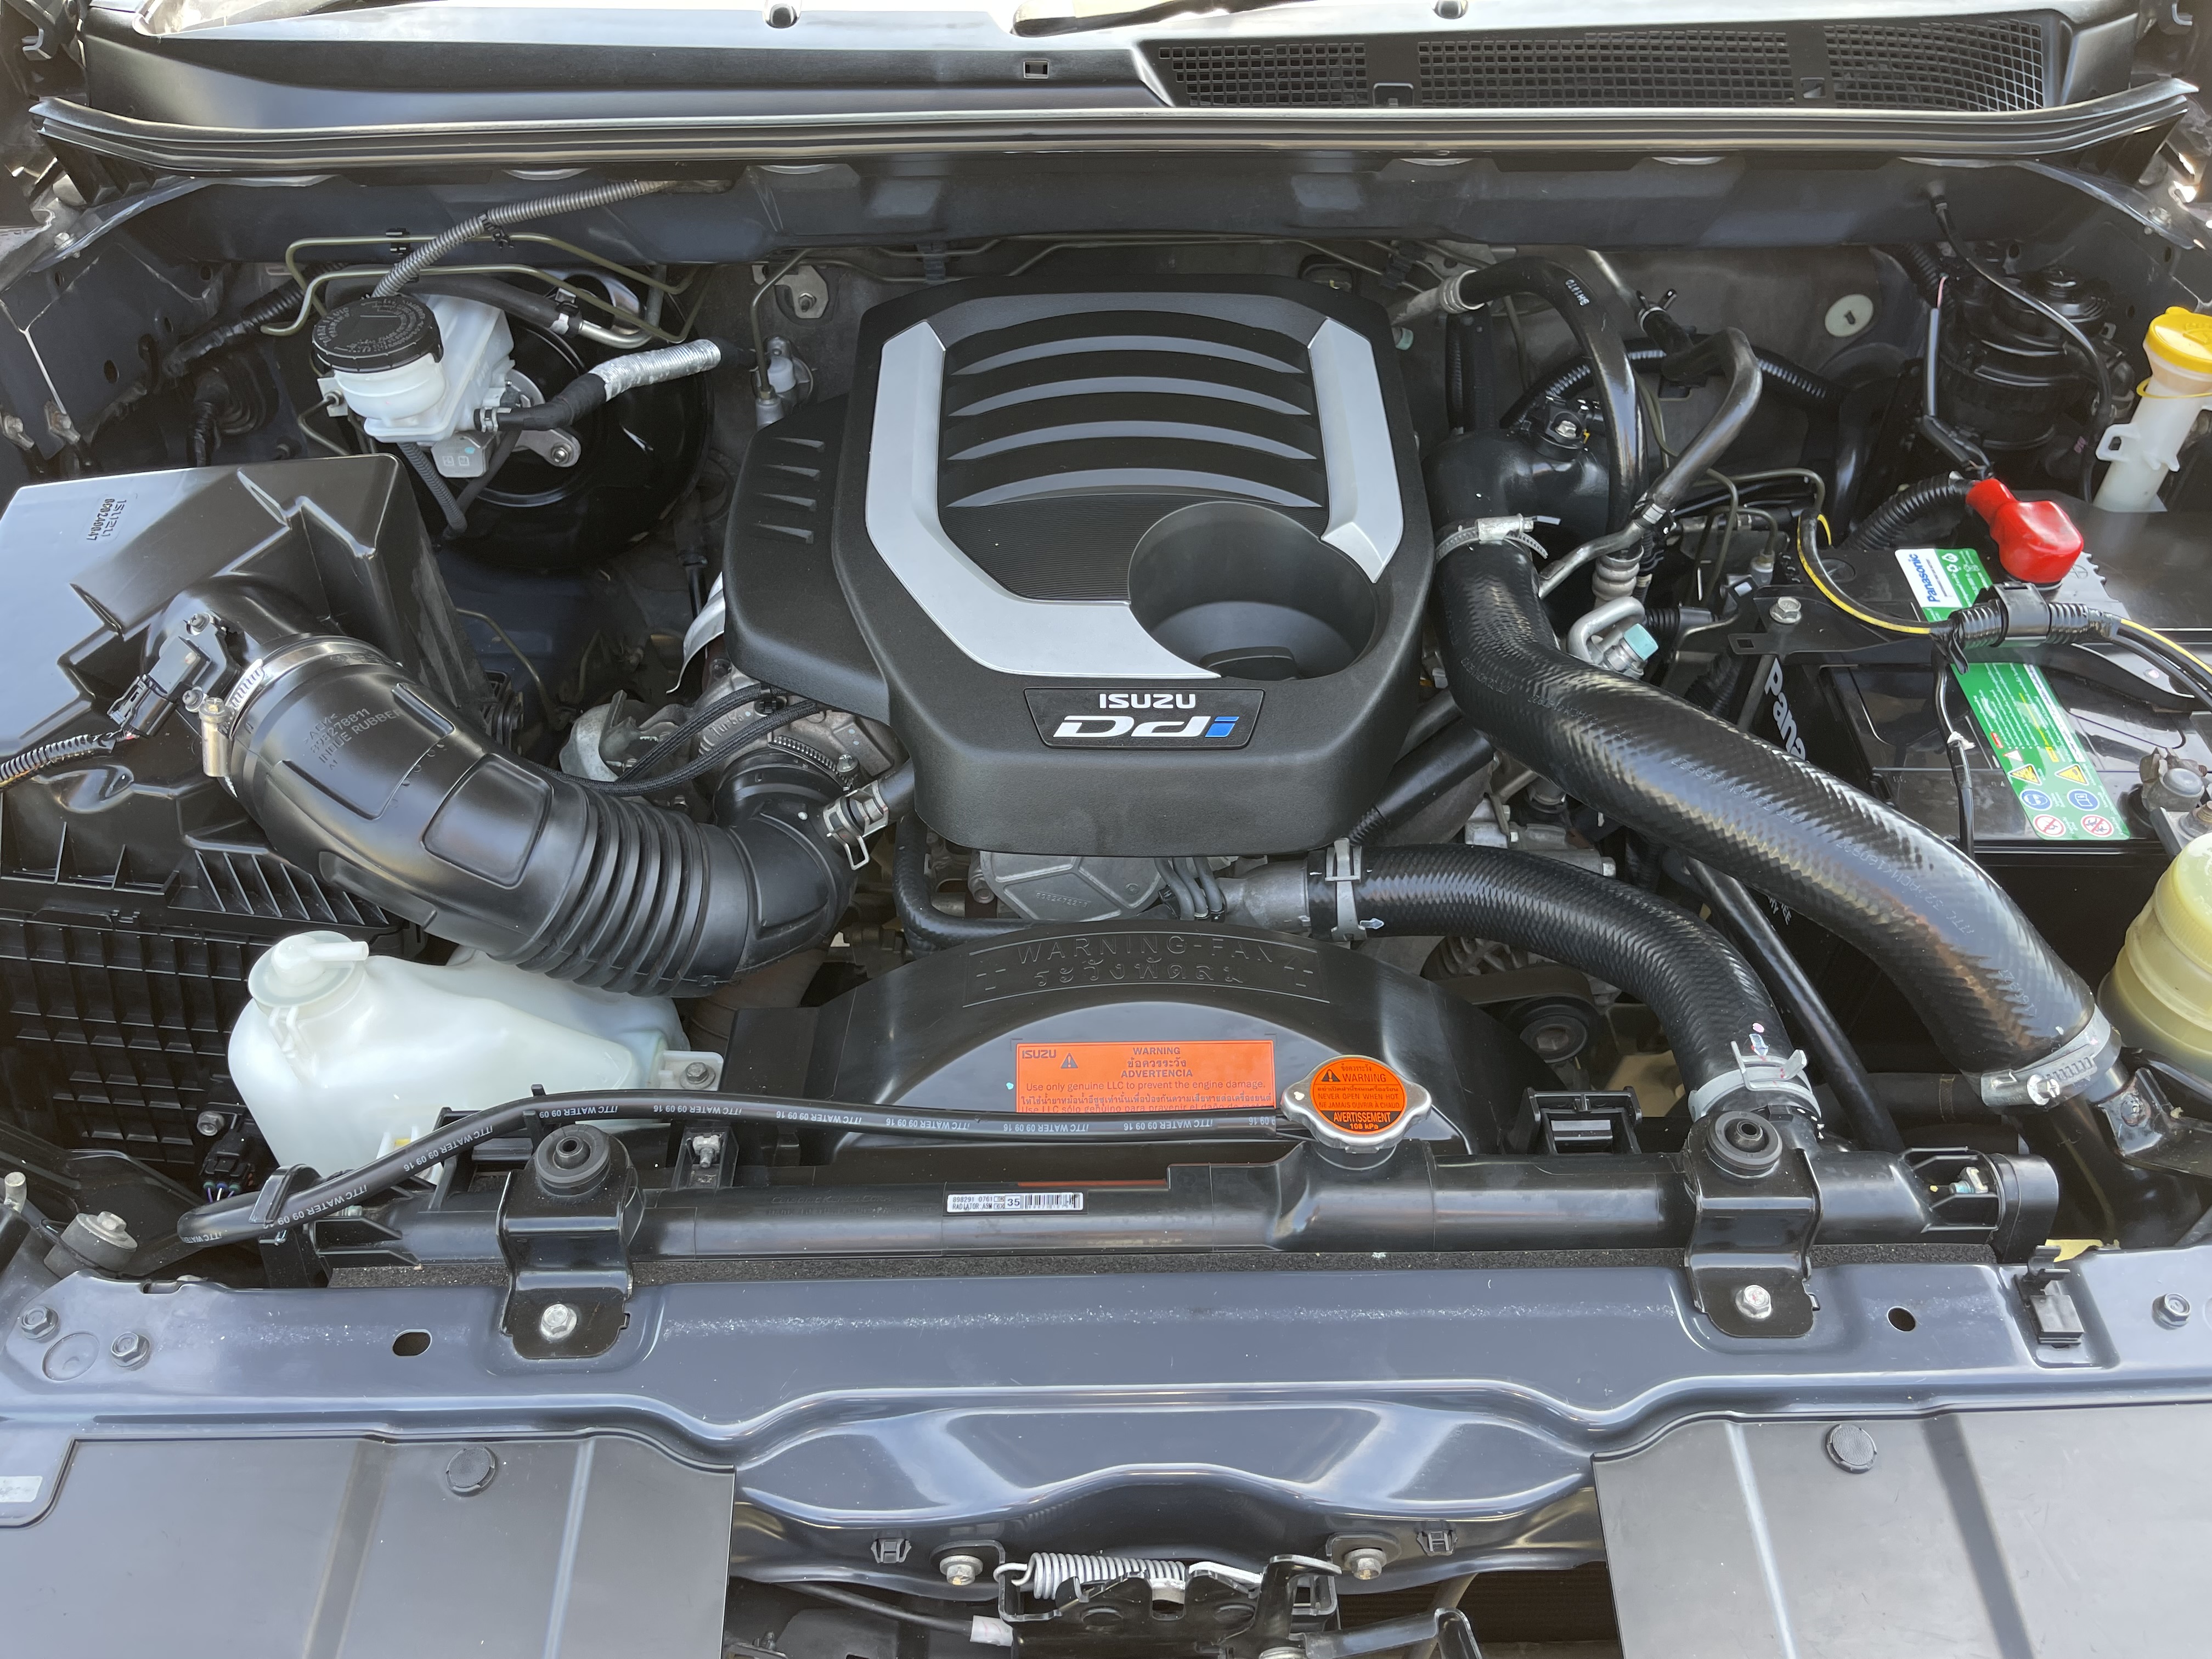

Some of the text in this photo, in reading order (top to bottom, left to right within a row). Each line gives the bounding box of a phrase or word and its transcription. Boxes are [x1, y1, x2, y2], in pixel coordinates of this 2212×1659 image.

[1908, 553, 1941, 603] Panasonic
[1099, 693, 1196, 709] ISUZU
[1022, 1049, 1057, 1059] ISUZU
[1132, 1047, 1181, 1056] WARNING
[1127, 1057, 1187, 1068] ข้อควรระวัง
[1121, 1069, 1193, 1079] ADVERTENCIA
[1342, 1074, 1386, 1082] WARNING
[1026, 1080, 1266, 1092] Use only genuine LLC to prevent the engine damage.
[551, 1108, 561, 1117] 09
[563, 1106, 596, 1116] WATER
[677, 1105, 687, 1113] 09
[689, 1106, 721, 1115] WATER
[539, 1110, 549, 1119] 09
[776, 1110, 786, 1119] 16
[788, 1111, 797, 1120] 09
[799, 1113, 809, 1121] 09
[811, 1114, 841, 1124] WATER
[1334, 1111, 1391, 1123] AVERTISSEMENT
[886, 1118, 895, 1126] 16
[897, 1119, 907, 1127] 09
[909, 1119, 918, 1127] 09
[919, 1120, 950, 1130] WATER
[1147, 1121, 1158, 1130] 09
[1160, 1120, 1192, 1130] WATER
[1249, 1117, 1258, 1125] 16
[1003, 1124, 1013, 1132] 16
[1015, 1124, 1024, 1132] 09
[1026, 1124, 1035, 1132] 09
[1037, 1124, 1068, 1132] WATER
[1124, 1122, 1133, 1131] 16
[439, 1135, 473, 1154] WATER
[428, 1149, 439, 1160] 09
[416, 1155, 427, 1166] 09
[403, 1162, 414, 1172] 16
[307, 1196, 345, 1216] WATER
[1007, 1198, 1020, 1206] 35
[278, 1213, 290, 1226] 09
[292, 1209, 305, 1221] 09
